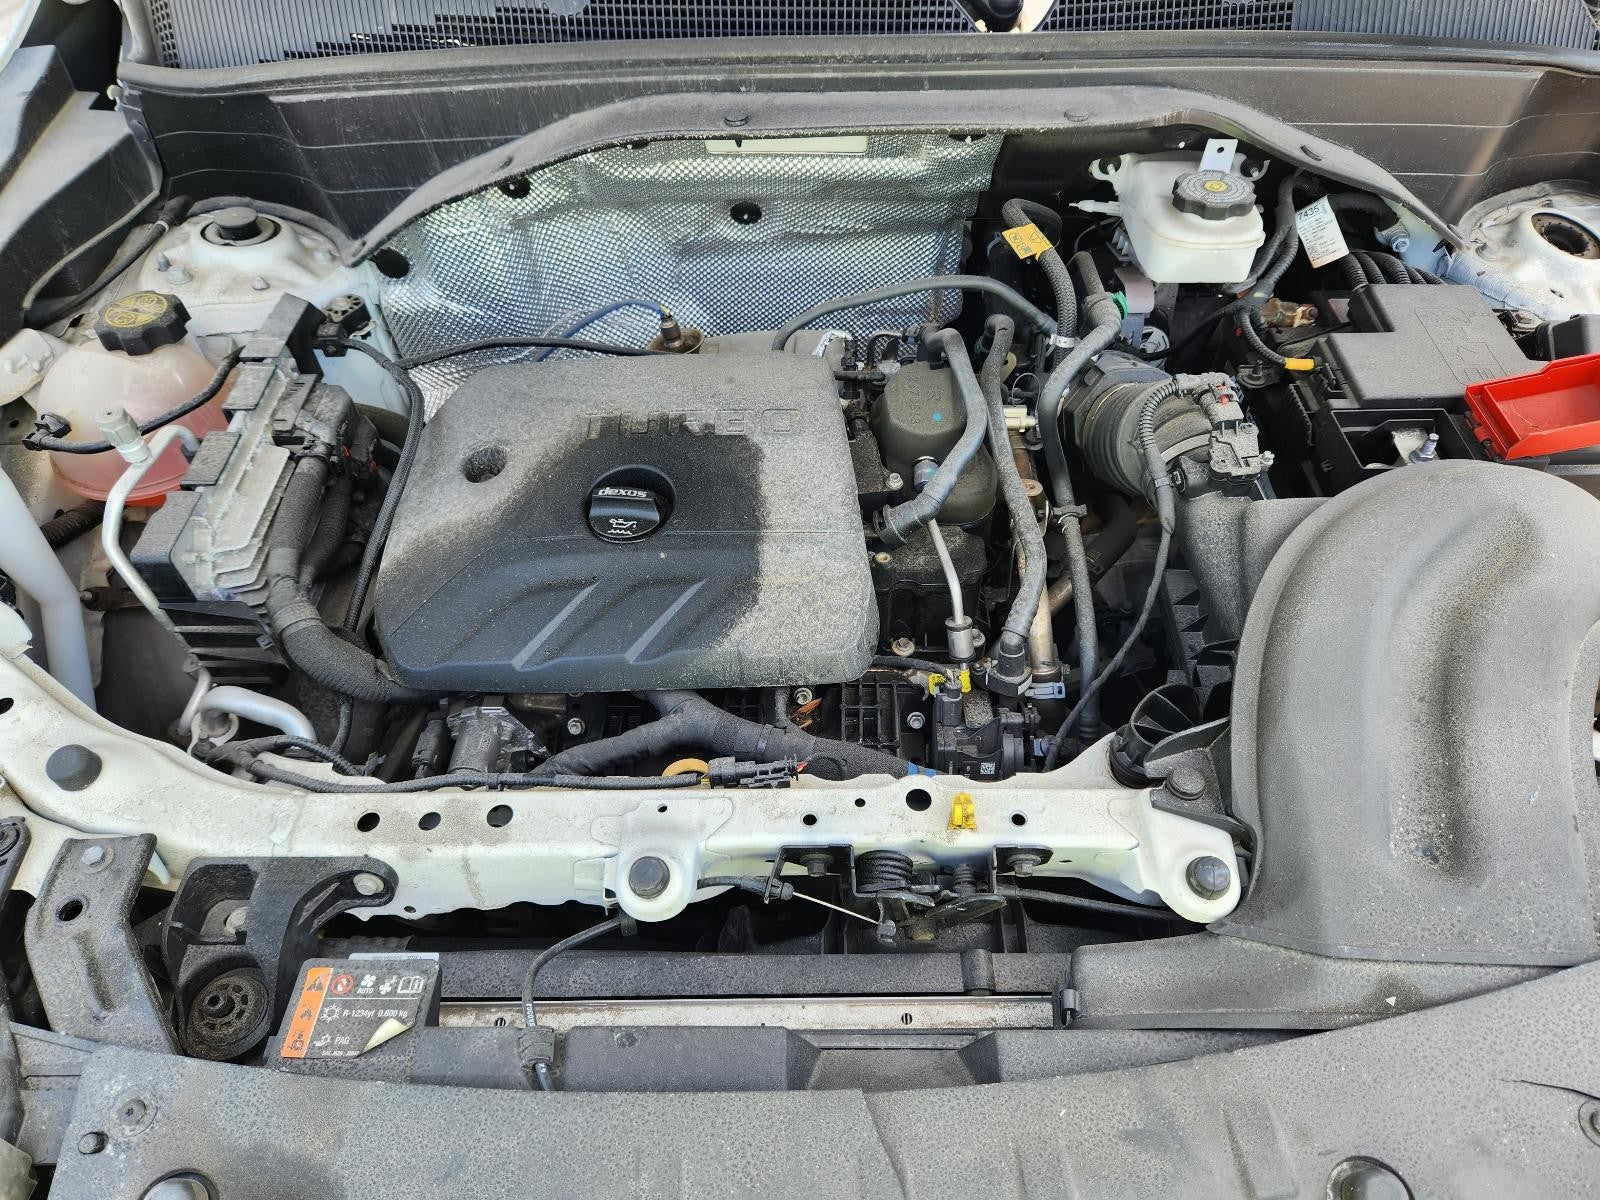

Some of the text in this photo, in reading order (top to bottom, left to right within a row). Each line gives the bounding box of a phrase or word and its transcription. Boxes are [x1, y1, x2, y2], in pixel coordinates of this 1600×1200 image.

[1298, 205, 1320, 220] 7435
[598, 487, 648, 498] dexos
[343, 1009, 375, 1018] R-1234yf
[398, 1009, 408, 1019] kg
[334, 1036, 350, 1045] PAG
